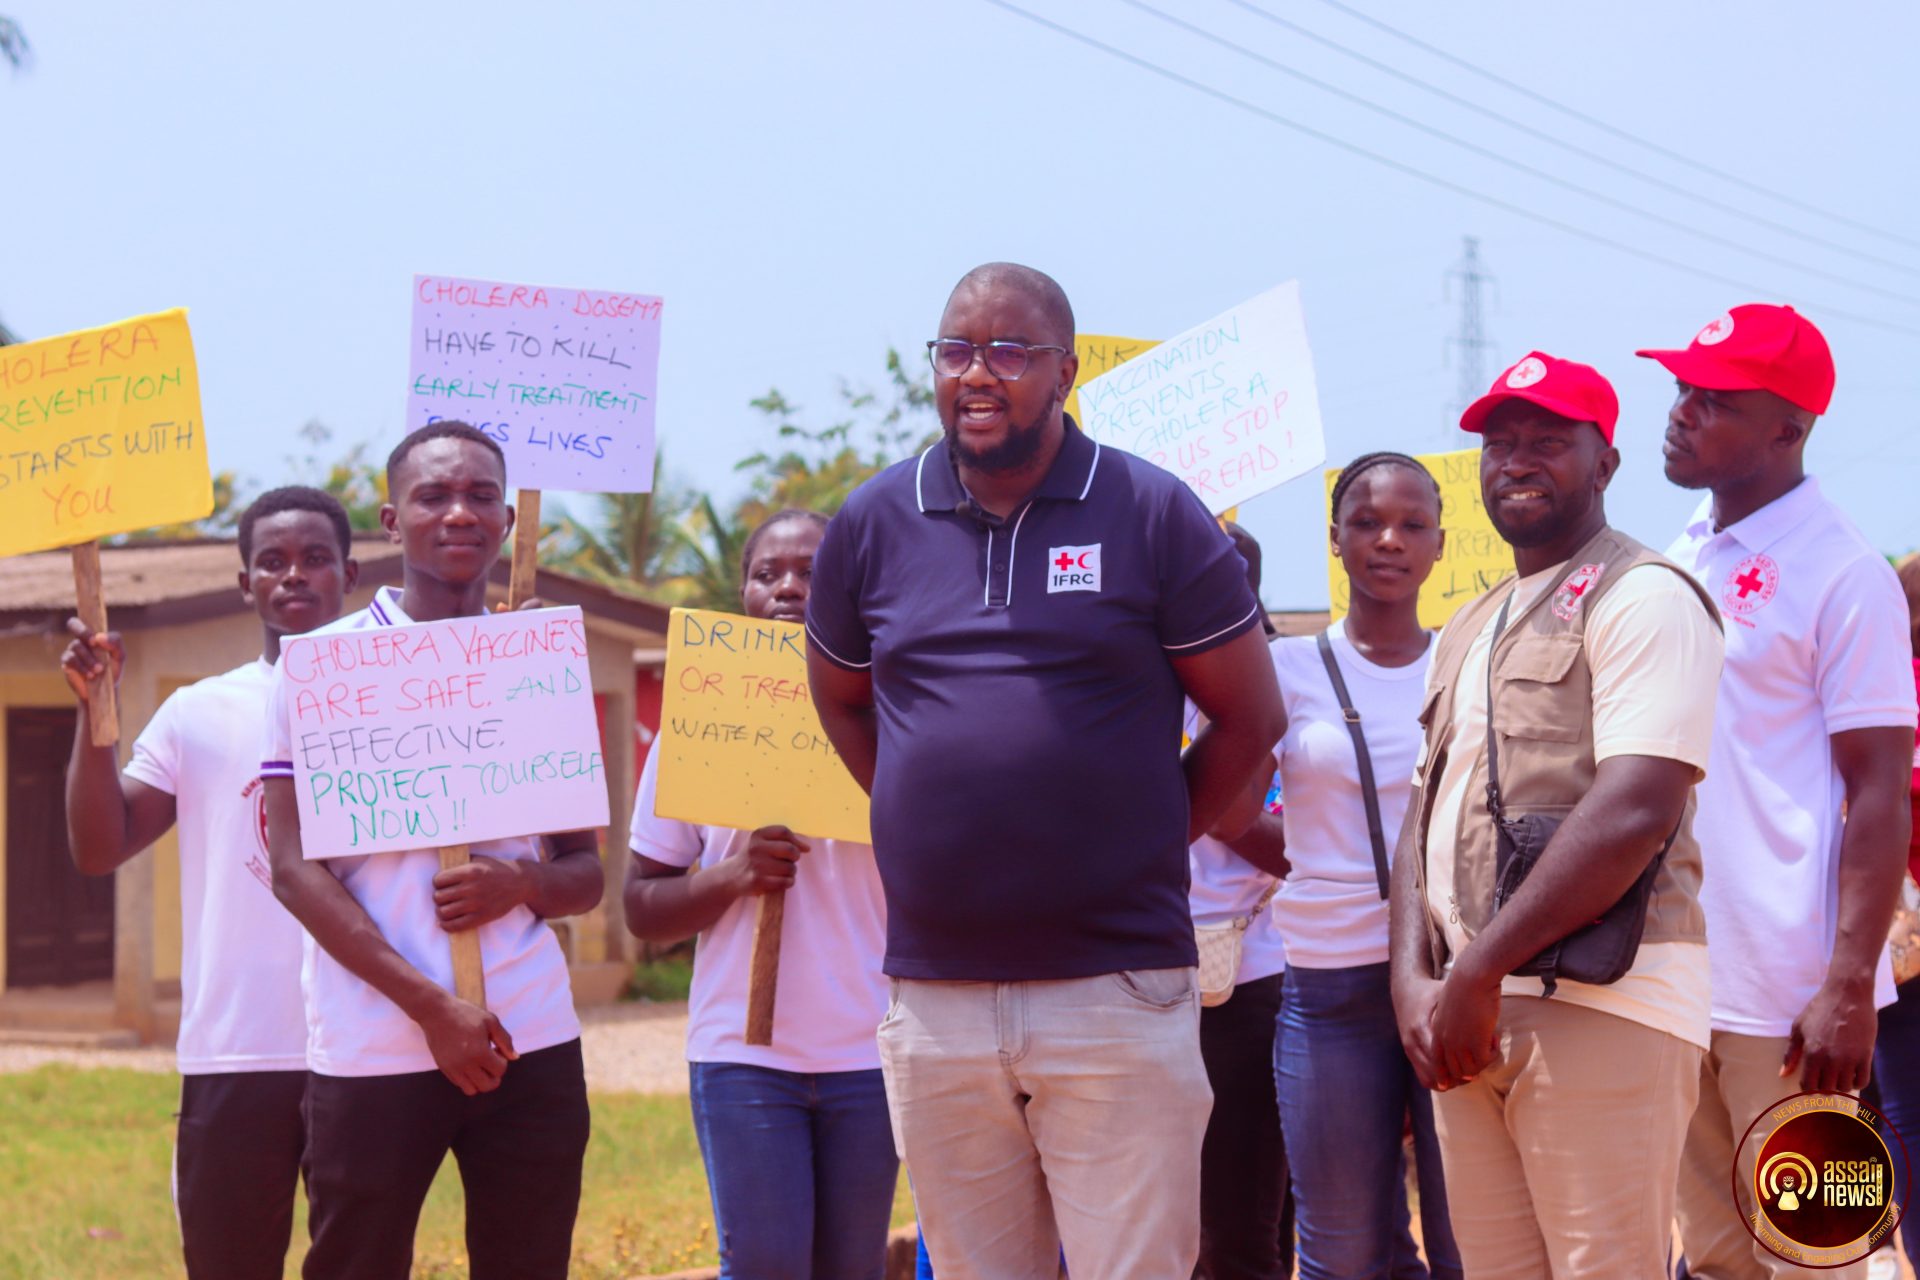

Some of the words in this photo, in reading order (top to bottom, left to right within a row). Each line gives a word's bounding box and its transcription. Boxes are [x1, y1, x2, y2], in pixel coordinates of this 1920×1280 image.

[419, 279, 548, 308] CHOLERA
[0, 324, 158, 389] HOLERA
[425, 327, 496, 356] HAVE
[506, 331, 541, 358] TO
[552, 338, 632, 369] KILL
[1076, 315, 1240, 411] VACCINATION
[0, 367, 181, 432] REVENTION
[413, 374, 500, 399] EARLY
[508, 382, 648, 413] TREATMENT
[1091, 362, 1226, 440] PREVENTS
[1133, 371, 1269, 455] CHOLERA
[124, 420, 193, 455] WITH
[527, 426, 612, 459] LIVES
[1178, 435, 1211, 470] US
[1222, 390, 1289, 446] STOP
[42, 483, 115, 525] YOU
[1053, 573, 1094, 587] IFRC
[283, 631, 442, 683] CHOLERA
[448, 619, 588, 665] VACCINES
[684, 614, 807, 662] DRINK
[297, 683, 379, 725] ARE
[506, 666, 582, 702] AND
[680, 666, 724, 696] OR
[741, 675, 808, 704] TREA
[672, 718, 779, 750] WATER
[791, 732, 838, 756] ON
[310, 765, 452, 815] PROTECT
